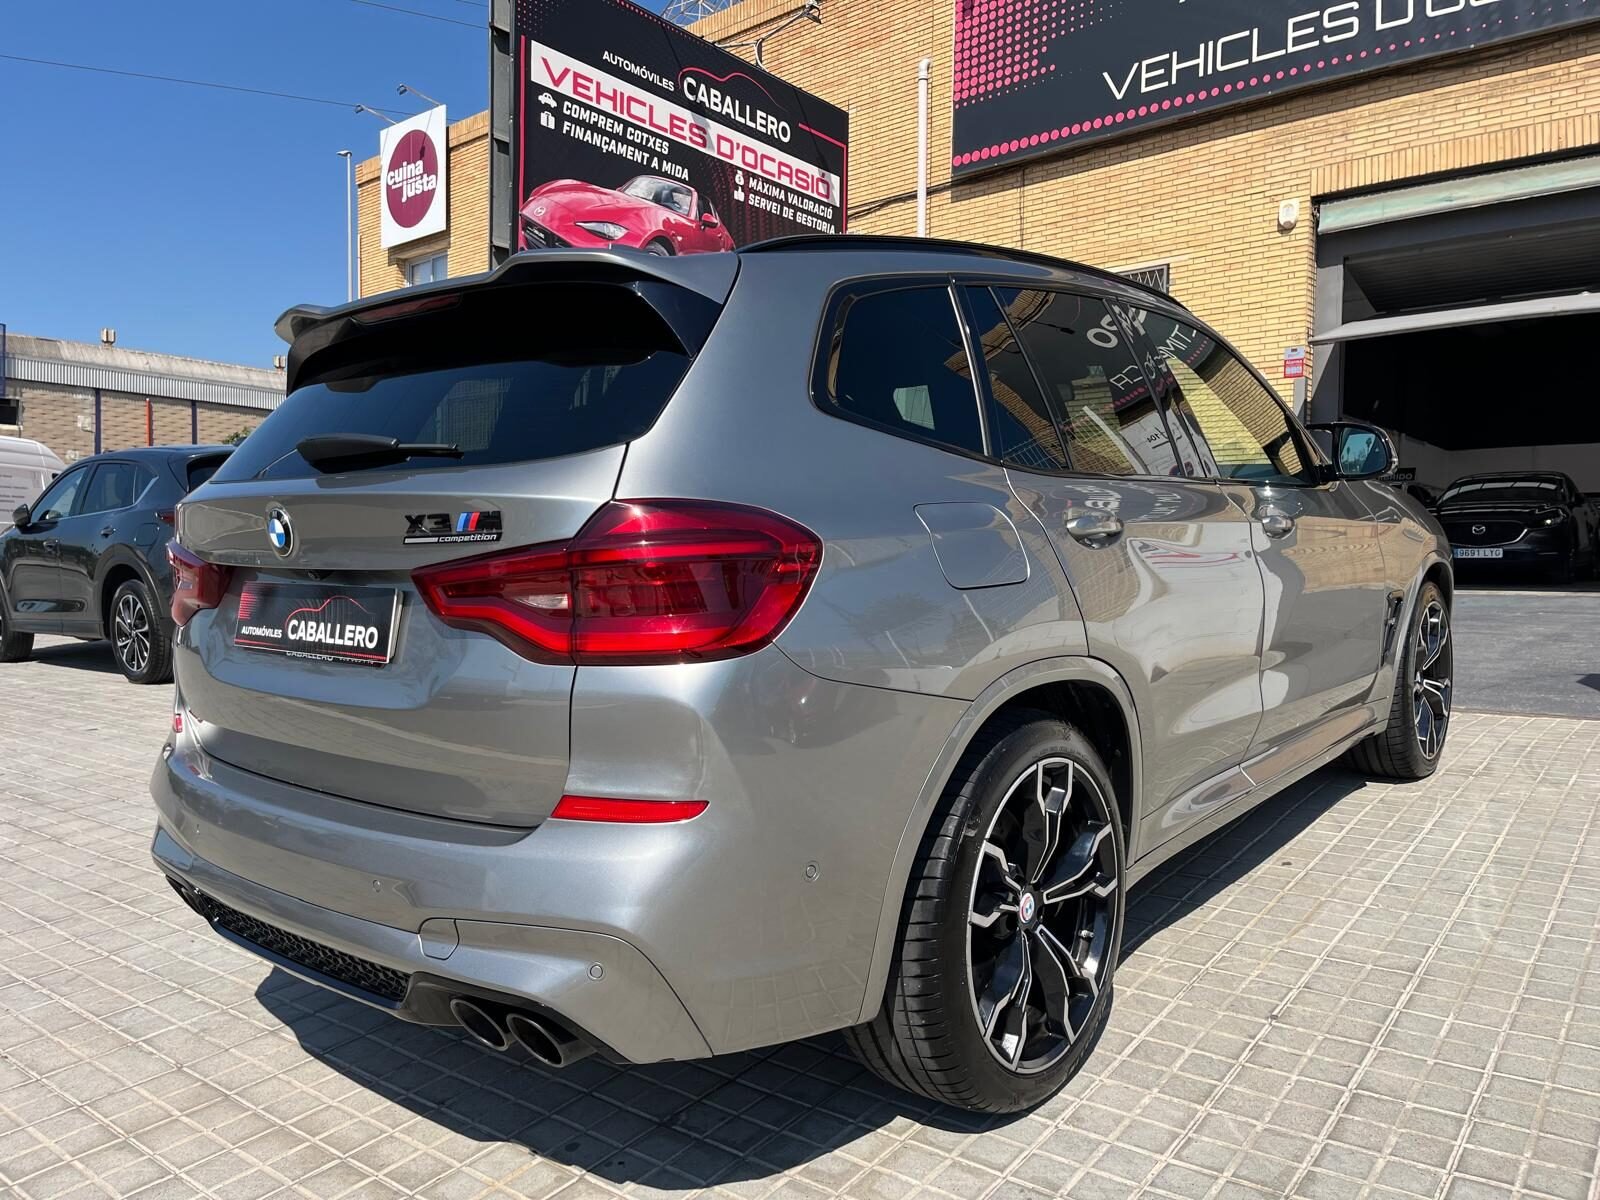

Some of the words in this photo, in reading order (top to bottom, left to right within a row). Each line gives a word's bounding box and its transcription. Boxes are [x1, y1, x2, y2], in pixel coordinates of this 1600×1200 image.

[1102, 2, 1360, 101] VEHICLES
[602, 50, 675, 92] AUTOMÓVILES
[683, 76, 791, 143] CABALLERO
[540, 56, 708, 149] VEHICLES
[716, 133, 831, 200] D'OCASIÓ
[562, 101, 623, 136] COMPREM
[626, 127, 670, 155] COTXES
[562, 120, 650, 166] FINANÇAMENT
[651, 157, 659, 170] A
[661, 160, 690, 181] MIDA
[388, 160, 423, 185] cuina
[402, 173, 436, 202] justa
[748, 176, 786, 202] MÀXIMA
[787, 191, 833, 220] VALORACIÓ
[748, 193, 781, 216] SERVEI
[782, 206, 795, 221] DE
[795, 211, 836, 235] GESTORIA
[404, 514, 452, 534] X3
[438, 533, 498, 543] competition
[241, 625, 283, 639] AUTOMÓVILES
[287, 619, 378, 649] CABALLERO
